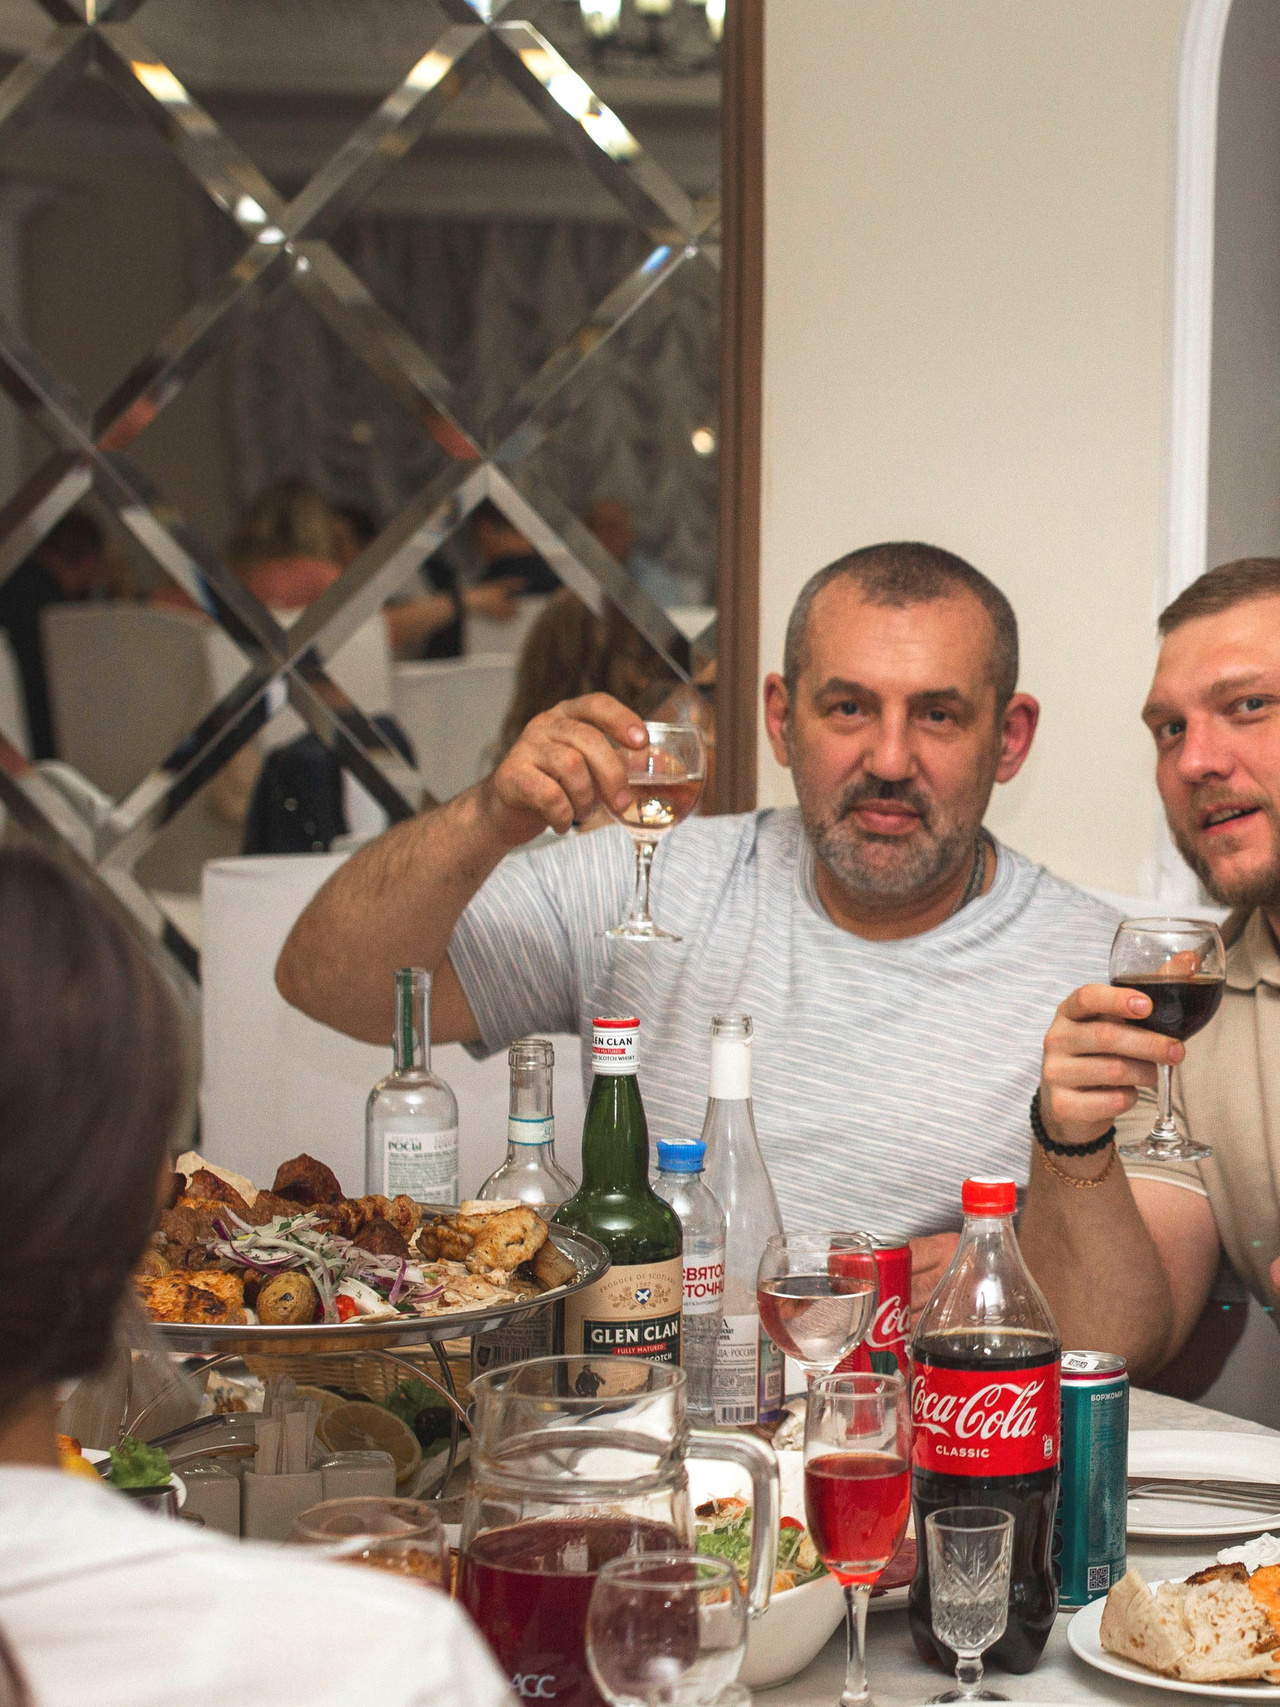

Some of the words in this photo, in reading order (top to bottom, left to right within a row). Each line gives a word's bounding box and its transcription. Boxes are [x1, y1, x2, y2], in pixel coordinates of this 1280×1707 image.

[606, 1037, 633, 1046] CLAN
[599, 1276, 633, 1294] PRODUCE
[636, 1273, 646, 1281] OF
[591, 1328, 639, 1344] GLEN
[643, 1320, 679, 1341] CLAN
[637, 1344, 664, 1353] MATURED
[1091, 1390, 1124, 1402] БОРЖОМИ
[911, 1379, 1045, 1440] Coca-Cola
[935, 1445, 990, 1459] CLASSIC
